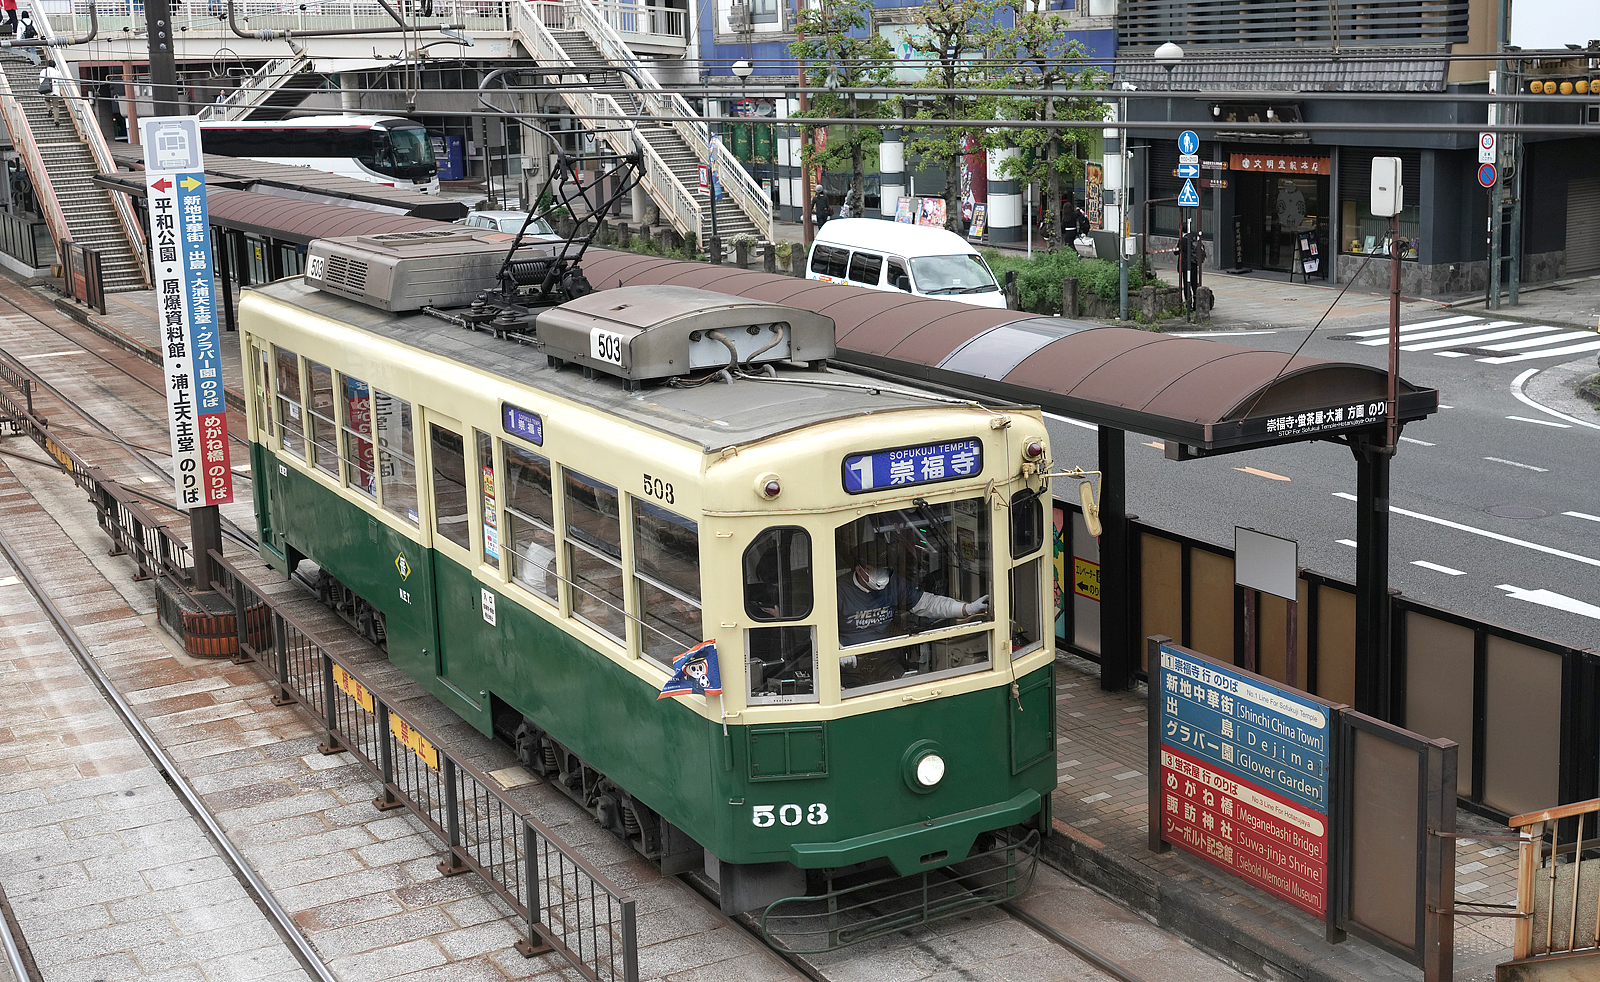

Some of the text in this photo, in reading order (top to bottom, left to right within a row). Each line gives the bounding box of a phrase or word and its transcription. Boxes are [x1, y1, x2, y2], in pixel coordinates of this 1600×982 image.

[311, 258, 324, 278] 503
[154, 197, 199, 505] 平和公園・原爆資料館・浦上天主堂 のりば
[598, 333, 621, 362] 503
[200, 380, 220, 409] のりば
[1347, 404, 1365, 420] 方面
[1368, 401, 1388, 417] のり
[508, 409, 515, 429] 1
[1278, 429, 1292, 437] STOP
[204, 415, 228, 501] めがね橋 のりば
[889, 440, 975, 461] SOFUKUJI TEMPLE
[850, 455, 874, 490] 1
[890, 451, 975, 485] 崇福寺
[643, 473, 675, 505] 503
[1174, 658, 1200, 679] 崇福寺
[1202, 668, 1211, 684] 行
[1213, 675, 1239, 693] のりば
[1166, 672, 1234, 716] 新地中華街
[1271, 717, 1295, 740] China
[1166, 695, 1234, 739] 出島
[1246, 689, 1318, 723] No.1 Line For Sofukuji Temple
[1166, 719, 1234, 764] グラバー園
[1174, 757, 1200, 780] 蛍茶屋
[1202, 769, 1211, 784] 行
[1213, 776, 1239, 796] のりば
[1166, 772, 1233, 818] めがね橋
[1251, 795, 1311, 829] No.3 Line For Hotarujaya
[752, 802, 829, 828] 503
[1166, 794, 1233, 841] 諏訪神社
[1166, 817, 1234, 865] シーボルト記念館
[1262, 864, 1291, 892] Memorial
